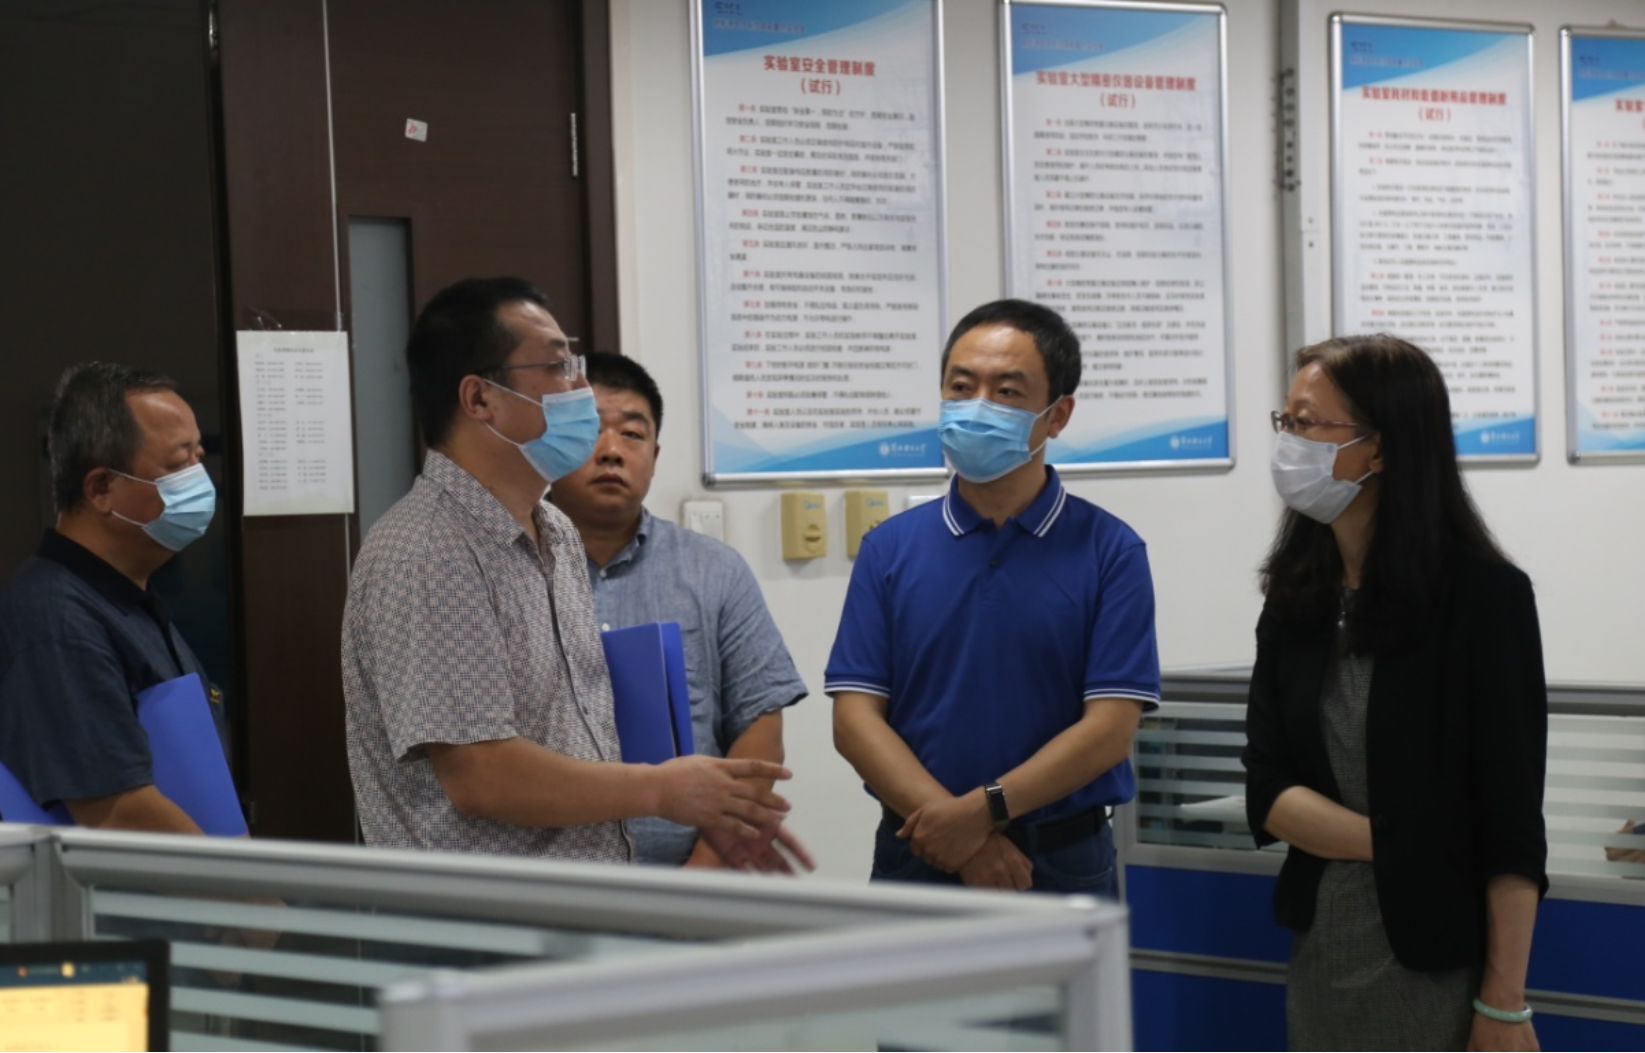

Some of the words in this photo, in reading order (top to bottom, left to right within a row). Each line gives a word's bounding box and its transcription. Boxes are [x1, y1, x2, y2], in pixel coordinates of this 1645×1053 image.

[764, 55, 875, 77] 实验室安全管理制度
[800, 78, 841, 95] （试行）
[1036, 71, 1197, 91] 实验室大型精密仪器设备管理制度
[1615, 99, 1645, 113] 实验室
